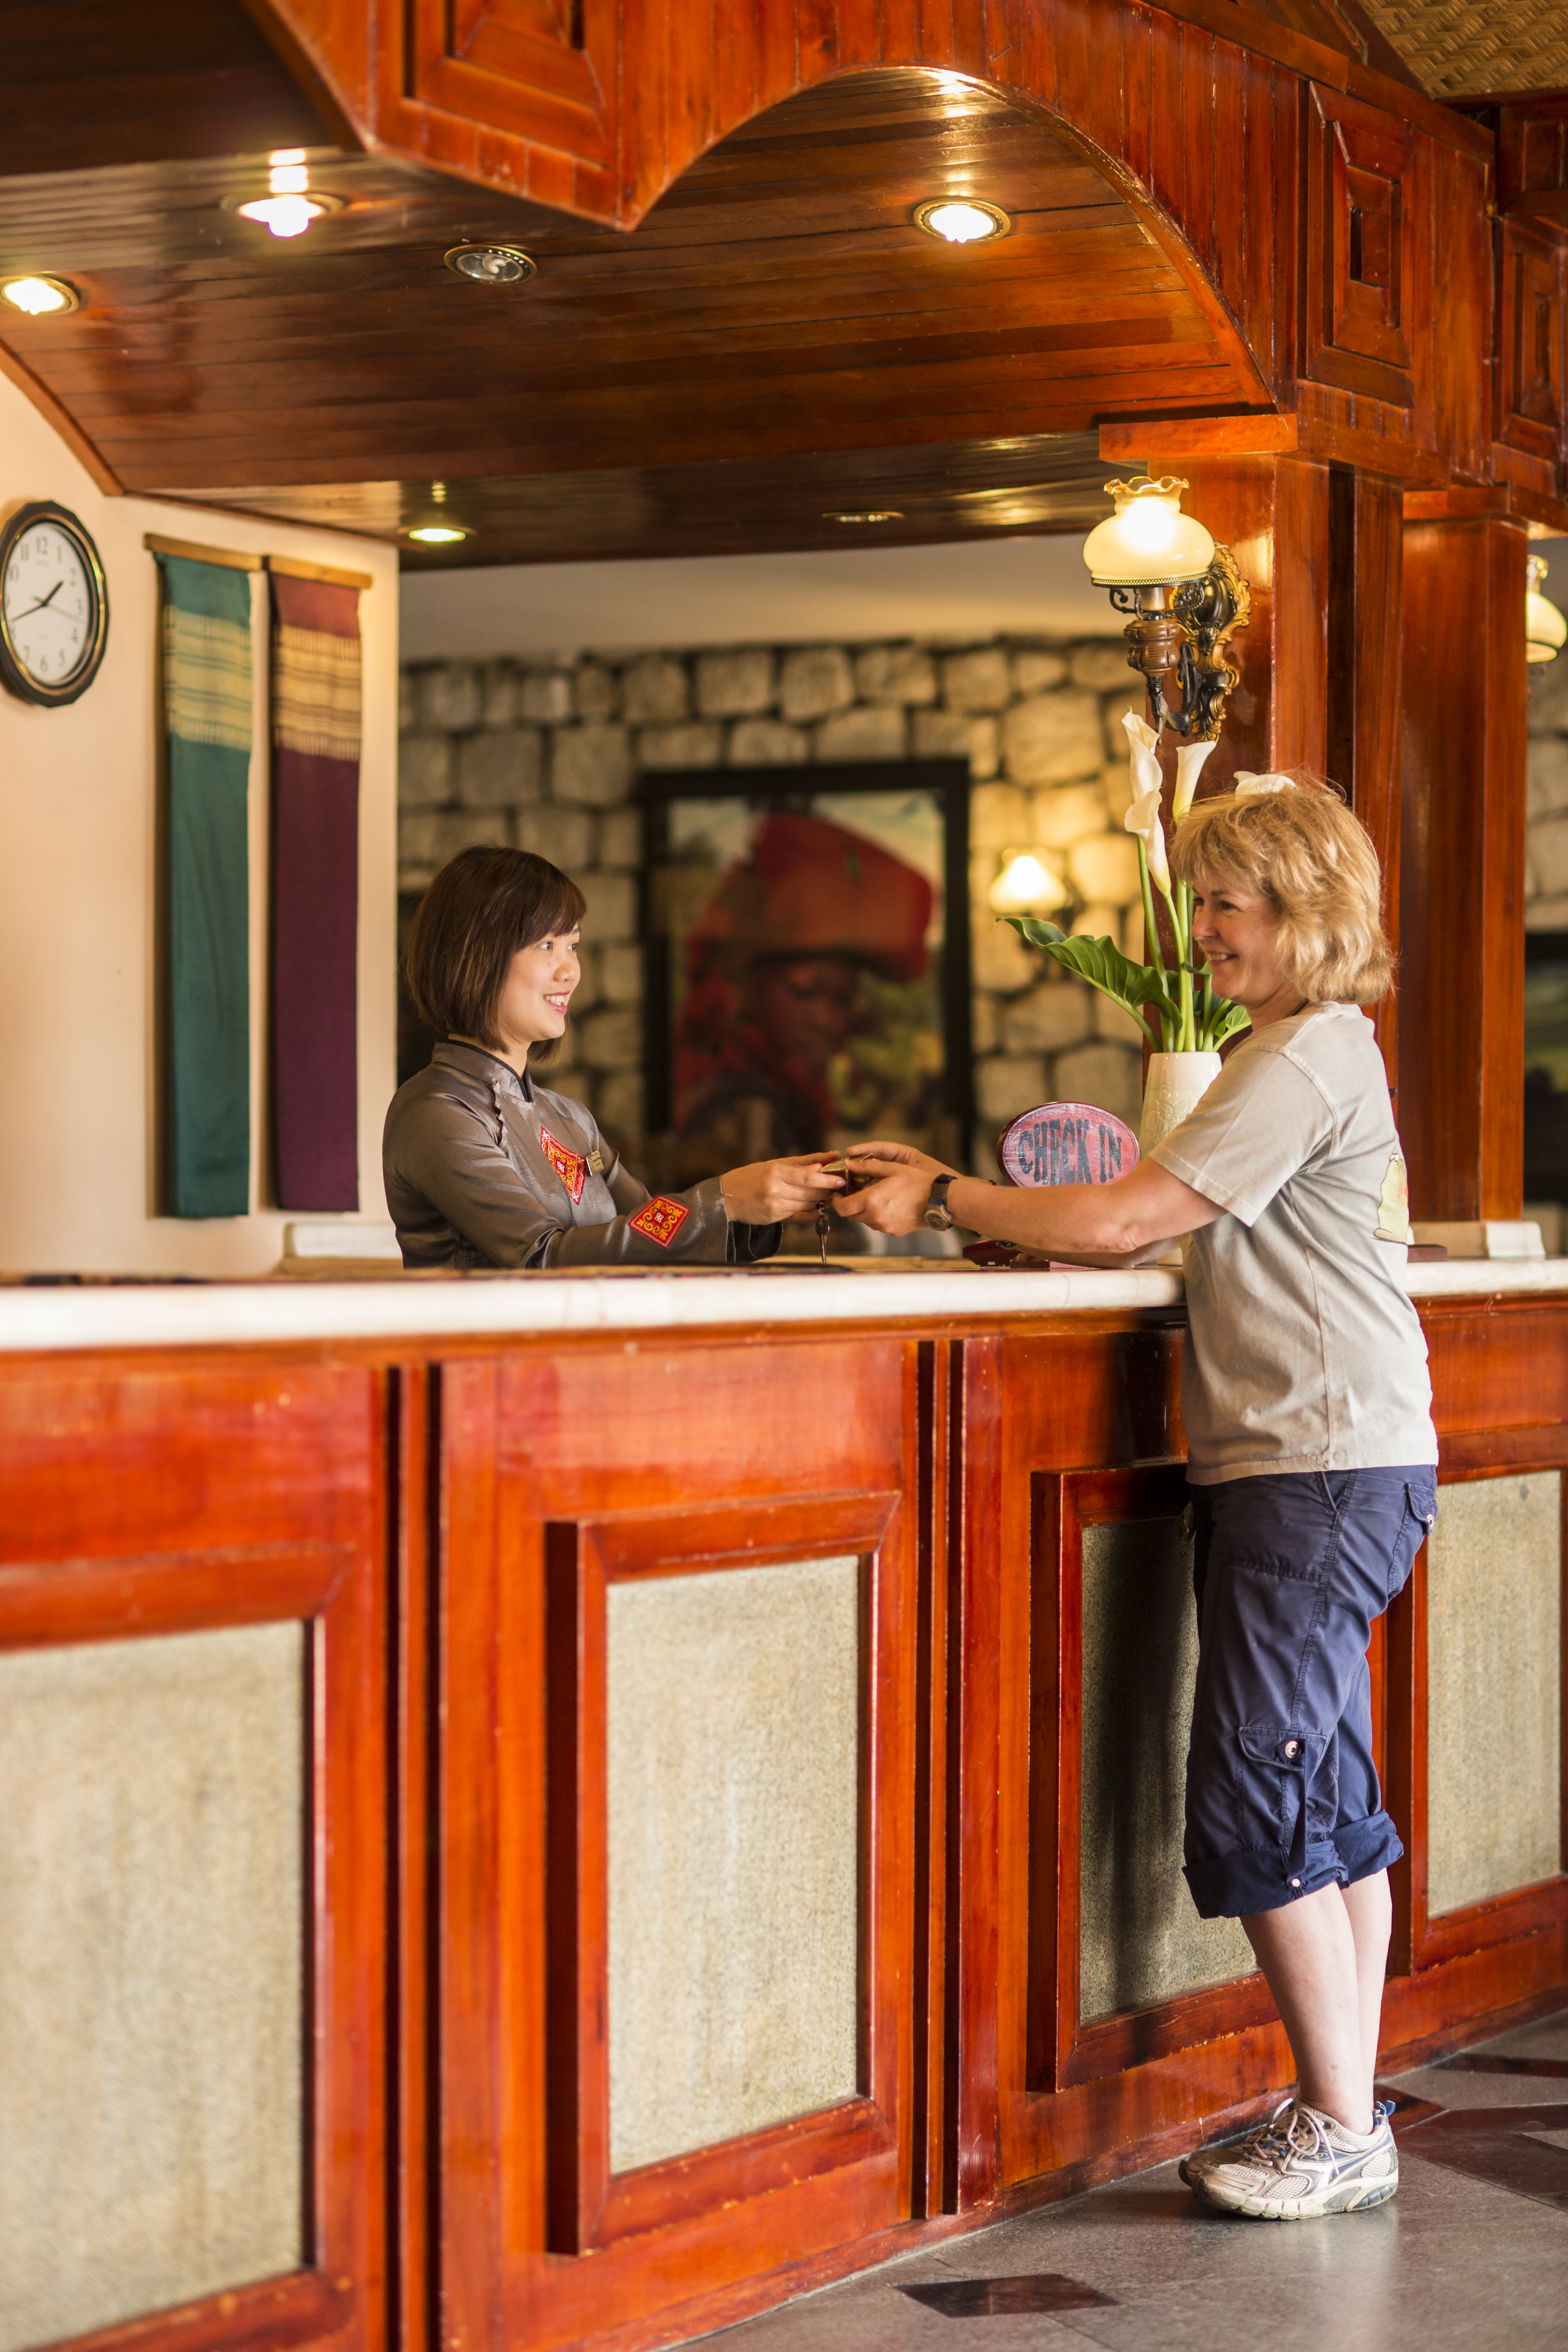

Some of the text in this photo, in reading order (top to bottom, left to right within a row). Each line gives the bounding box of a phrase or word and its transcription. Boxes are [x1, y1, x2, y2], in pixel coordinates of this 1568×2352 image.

[21, 543, 29, 561] 11
[36, 536, 48, 555] 12
[57, 545, 62, 564] 1
[70, 568, 76, 586] 2
[76, 598, 83, 616] 3
[71, 627, 78, 643] 4
[24, 646, 30, 664] 7
[40, 655, 48, 673] 6
[58, 649, 65, 667] 5
[1019, 1118, 1122, 1185] CHECK IN
